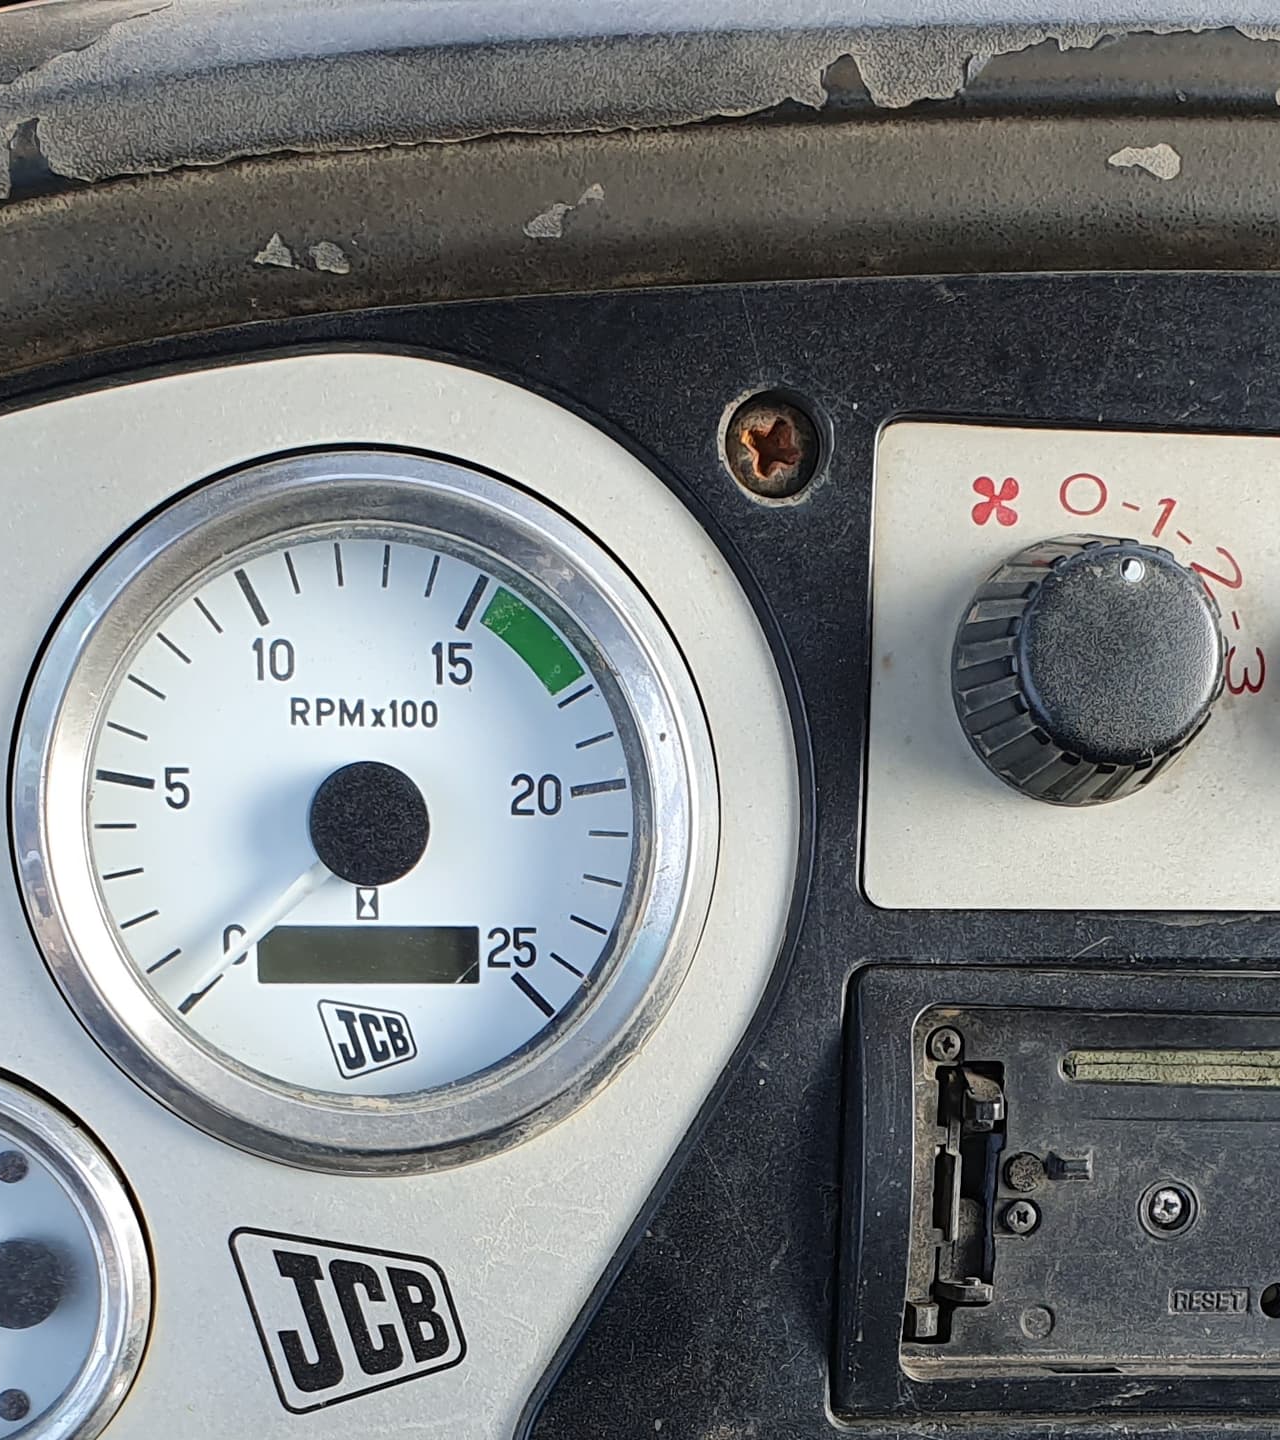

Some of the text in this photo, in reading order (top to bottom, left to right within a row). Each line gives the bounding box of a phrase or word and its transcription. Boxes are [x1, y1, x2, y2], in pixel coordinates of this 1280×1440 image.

[252, 638, 295, 681] 10
[432, 641, 473, 685] 15
[165, 767, 190, 810] 5
[510, 774, 562, 816] 20
[487, 928, 537, 968] 25
[335, 1009, 410, 1070] JCB
[271, 1249, 450, 1392] JCB
[1173, 1290, 1244, 1311] RESET
